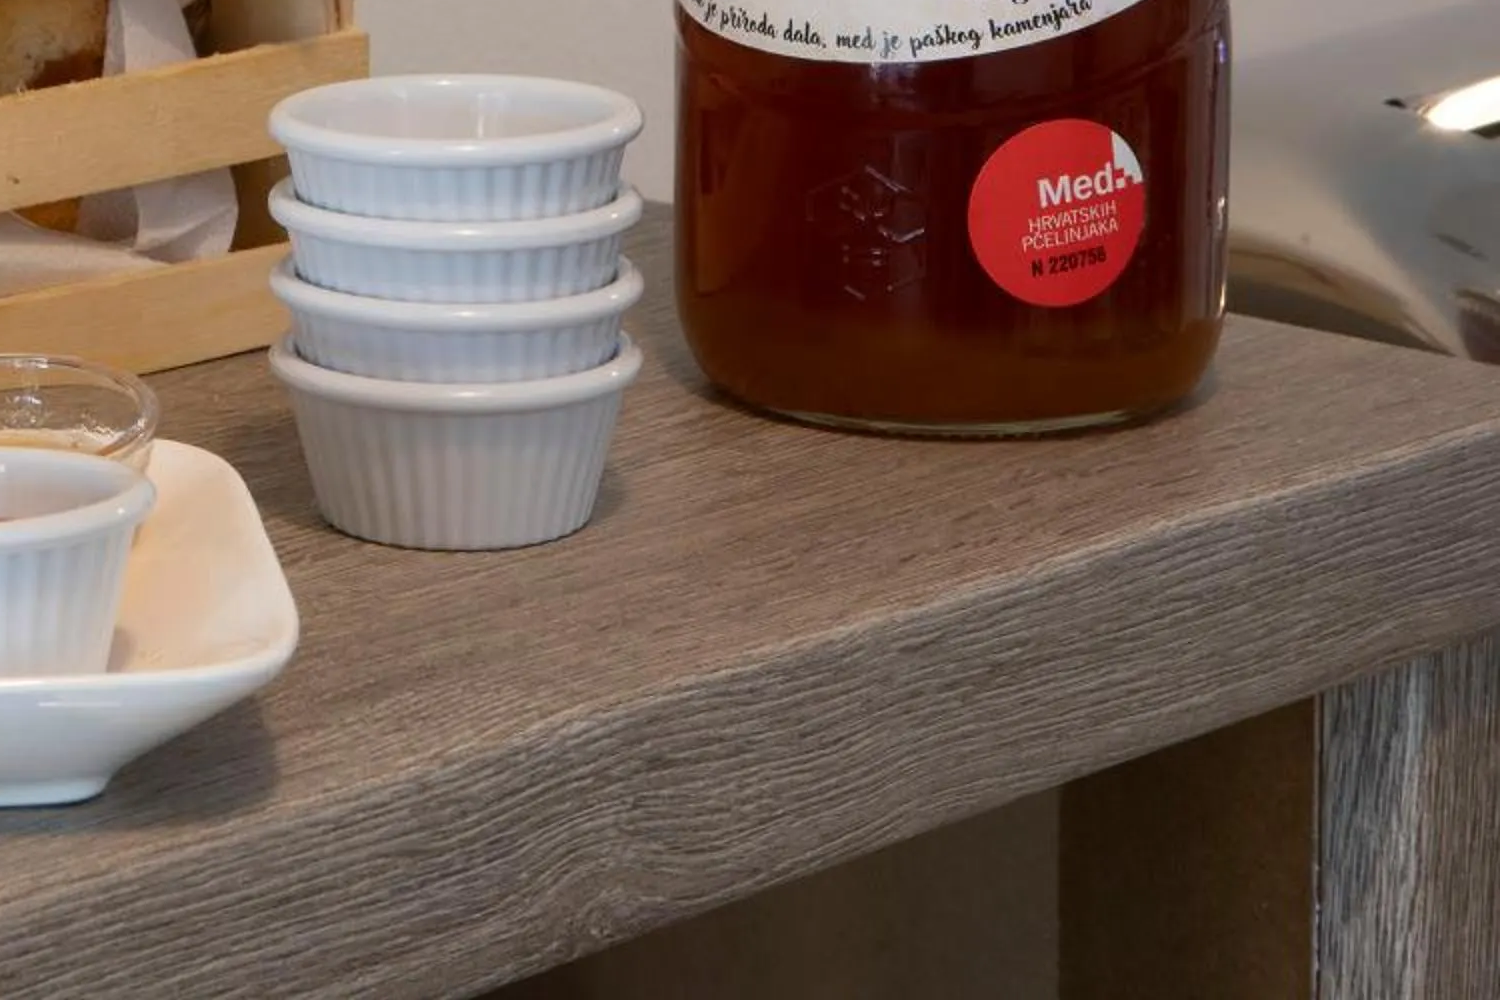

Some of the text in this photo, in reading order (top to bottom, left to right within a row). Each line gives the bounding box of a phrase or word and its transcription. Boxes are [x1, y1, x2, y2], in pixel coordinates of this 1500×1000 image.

[836, 26, 874, 49] med
[910, 24, 984, 57] paškog
[1028, 200, 1117, 233] HRVATSKIH
[1031, 258, 1044, 277] N
